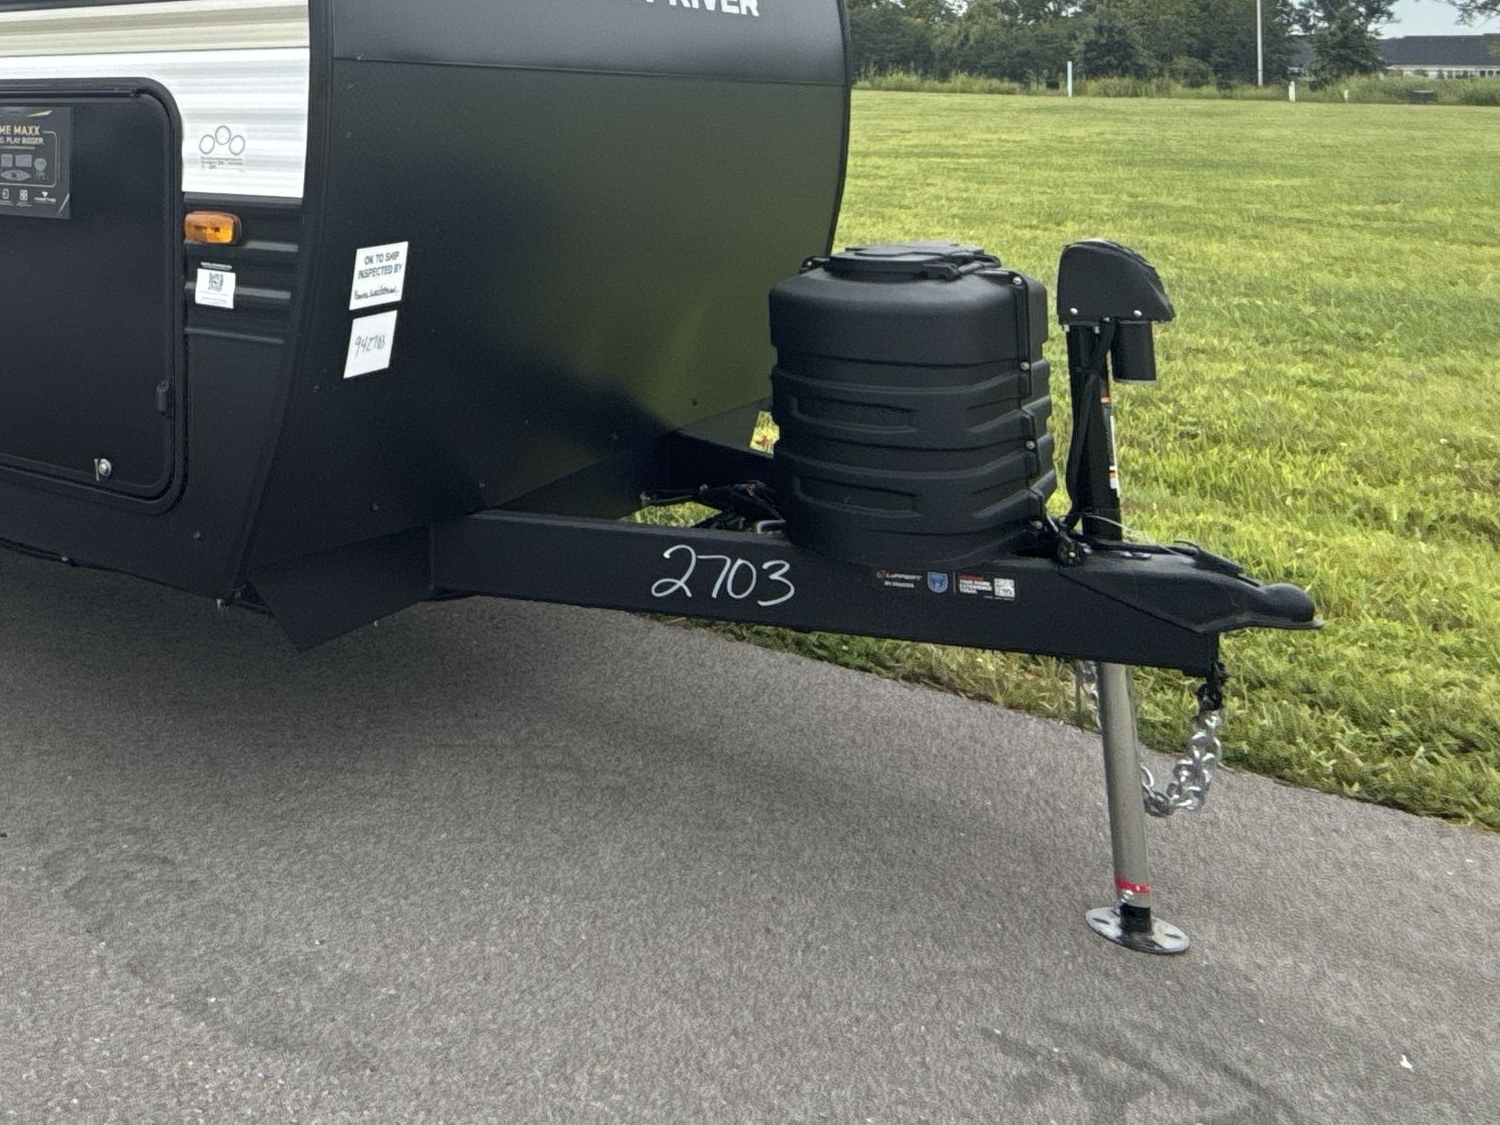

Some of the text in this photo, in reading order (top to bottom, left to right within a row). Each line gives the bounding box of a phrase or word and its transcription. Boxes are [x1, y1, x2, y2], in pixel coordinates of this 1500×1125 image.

[13, 125, 41, 135] MAXX
[364, 251, 399, 265] OK TO SHIP
[357, 263, 403, 279] INSPECTED BY
[651, 545, 795, 606] 2703
